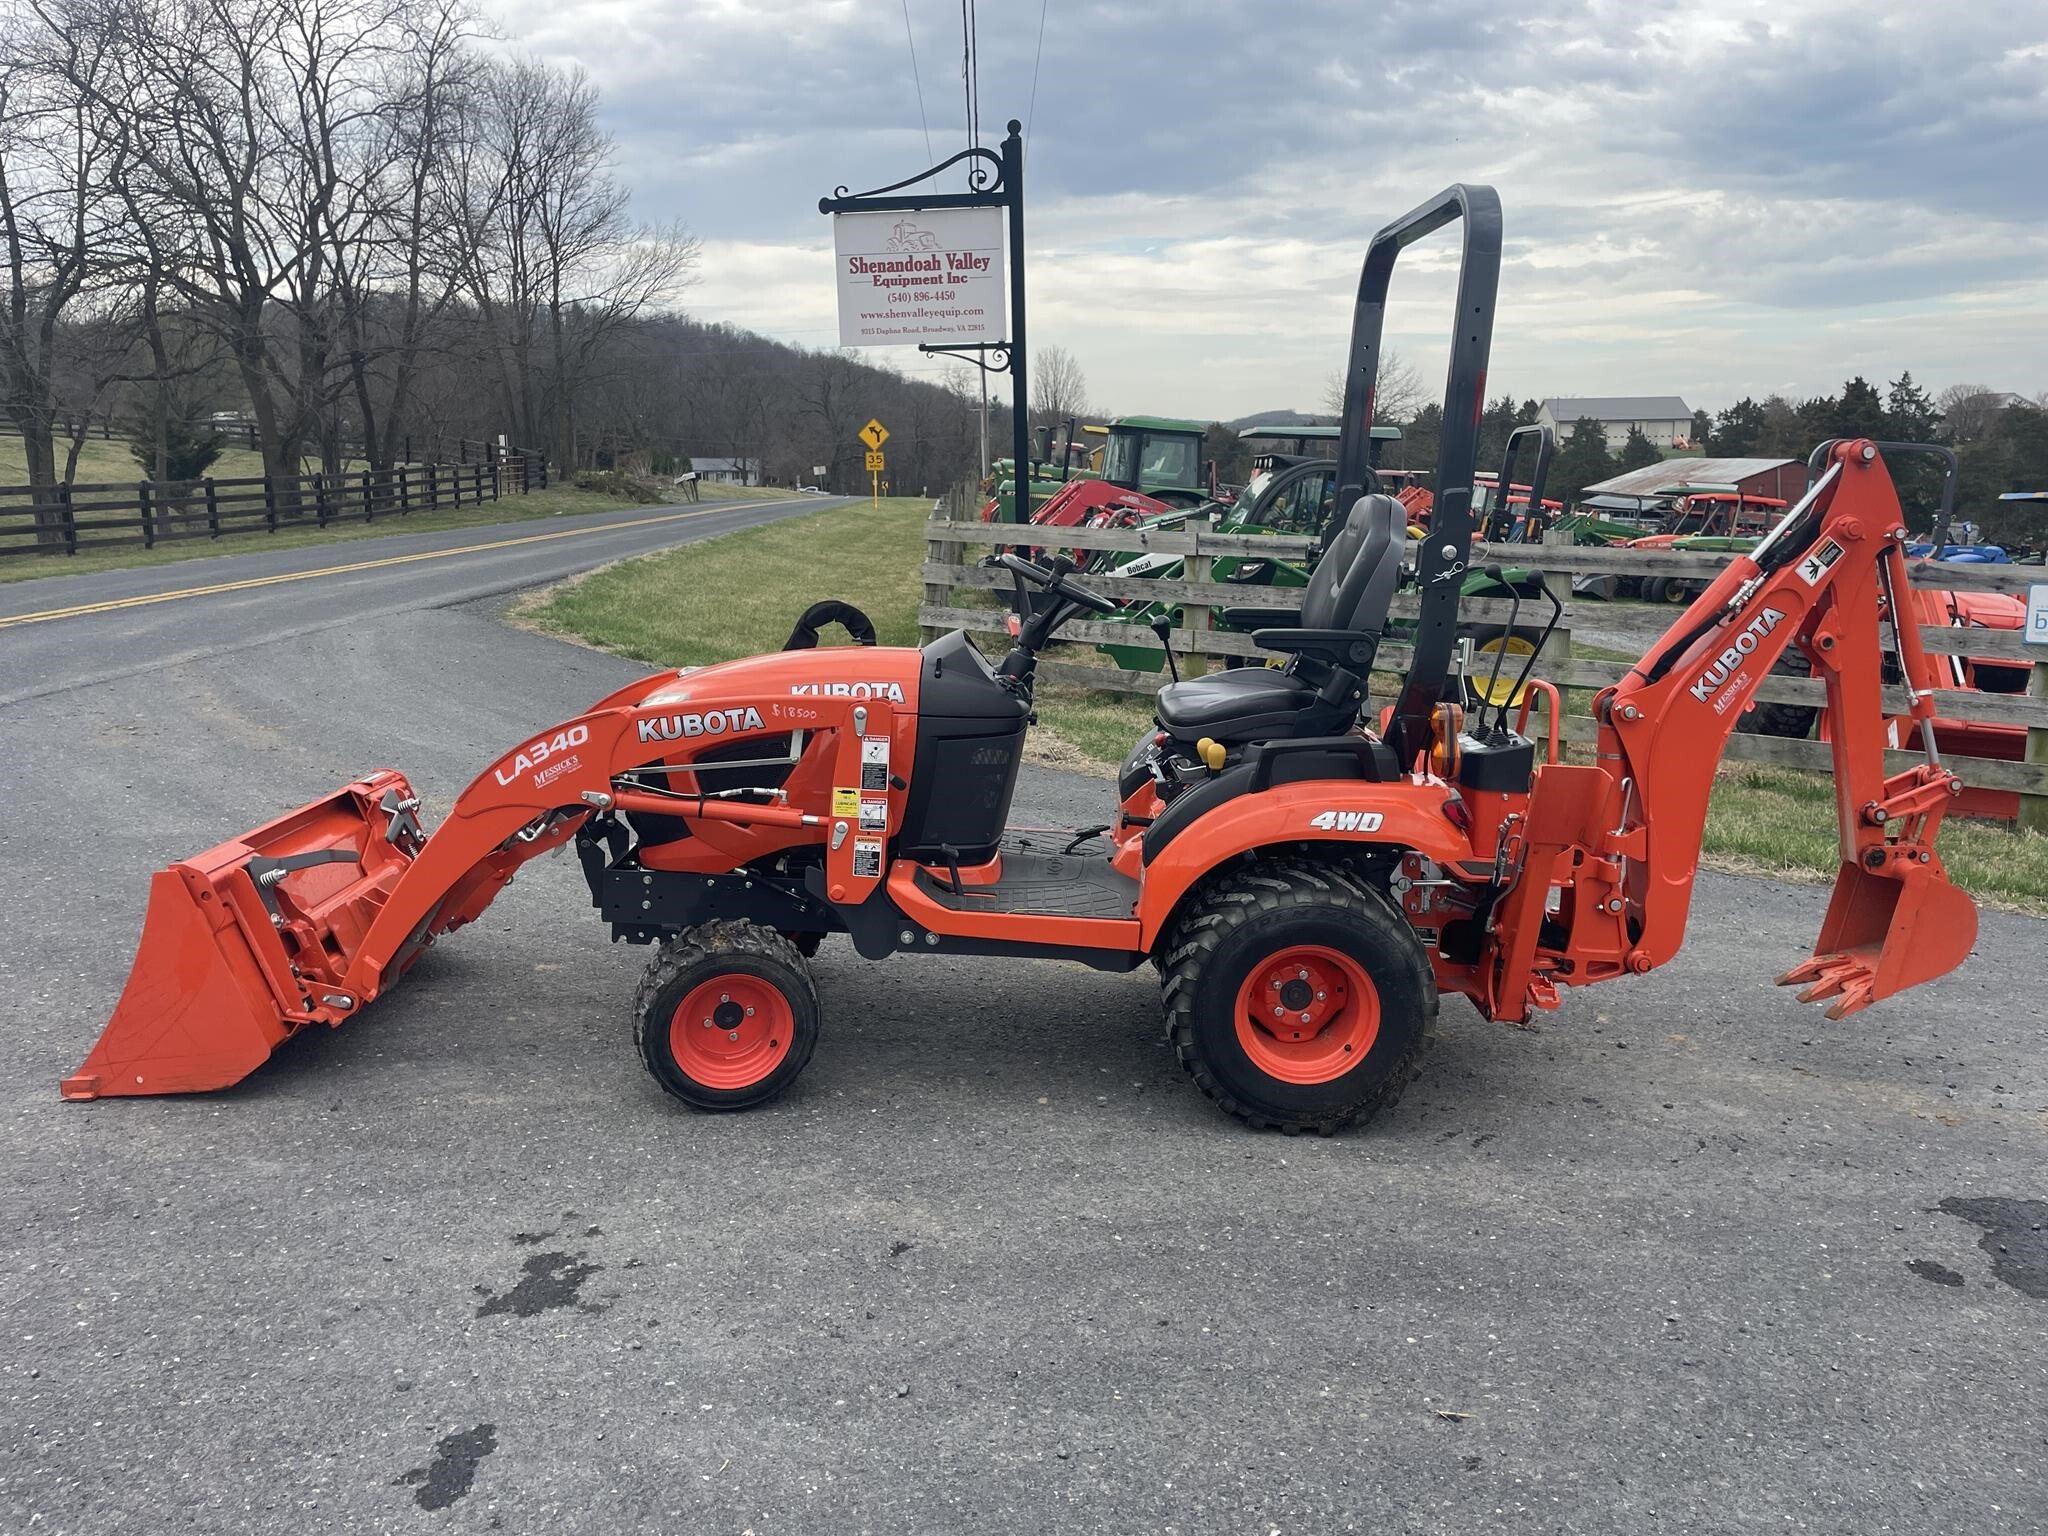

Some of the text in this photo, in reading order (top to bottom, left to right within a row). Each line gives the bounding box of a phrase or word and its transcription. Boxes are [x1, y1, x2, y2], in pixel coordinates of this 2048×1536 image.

[849, 252, 991, 275] Shenandoah Valley
[872, 271, 969, 289] Equipment Inc
[887, 290, 956, 304] (540) 896-4450
[860, 306, 984, 320] www.shenvalleyequip.com
[957, 324, 966, 332] VA
[868, 454, 883, 464] 35
[1126, 560, 1152, 575] Bobcat
[1688, 606, 1787, 704] KUBOTA
[791, 681, 907, 705] KUBOTA
[637, 705, 767, 743] KUBOTA
[494, 725, 589, 786] LA340
[533, 755, 579, 787] MESSICK'S
[1309, 810, 1385, 833] 4WD
